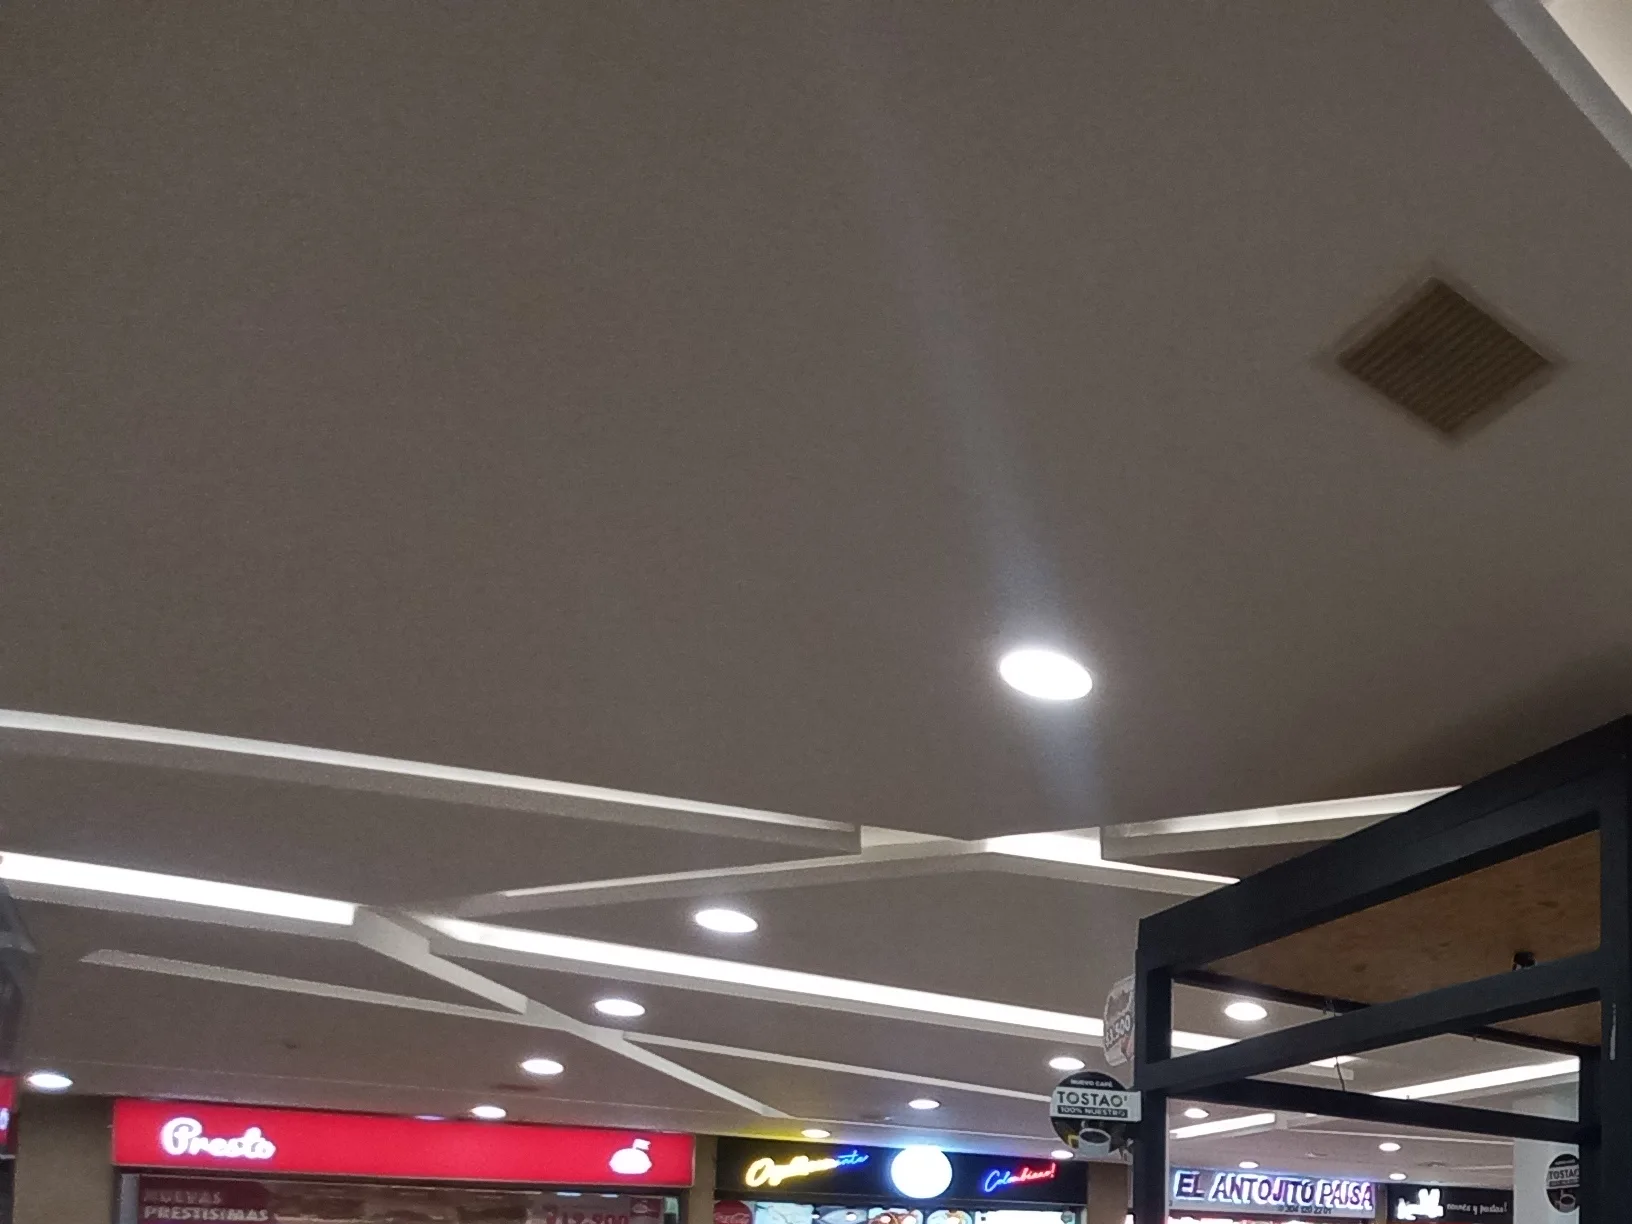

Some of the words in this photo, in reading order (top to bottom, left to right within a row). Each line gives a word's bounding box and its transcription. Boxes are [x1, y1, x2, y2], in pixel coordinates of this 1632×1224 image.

[160, 1116, 276, 1159] Presto
[1174, 1171, 1205, 1200] EL
[1211, 1173, 1315, 1204] ANTOJITO
[1317, 1181, 1375, 1209] PAISA
